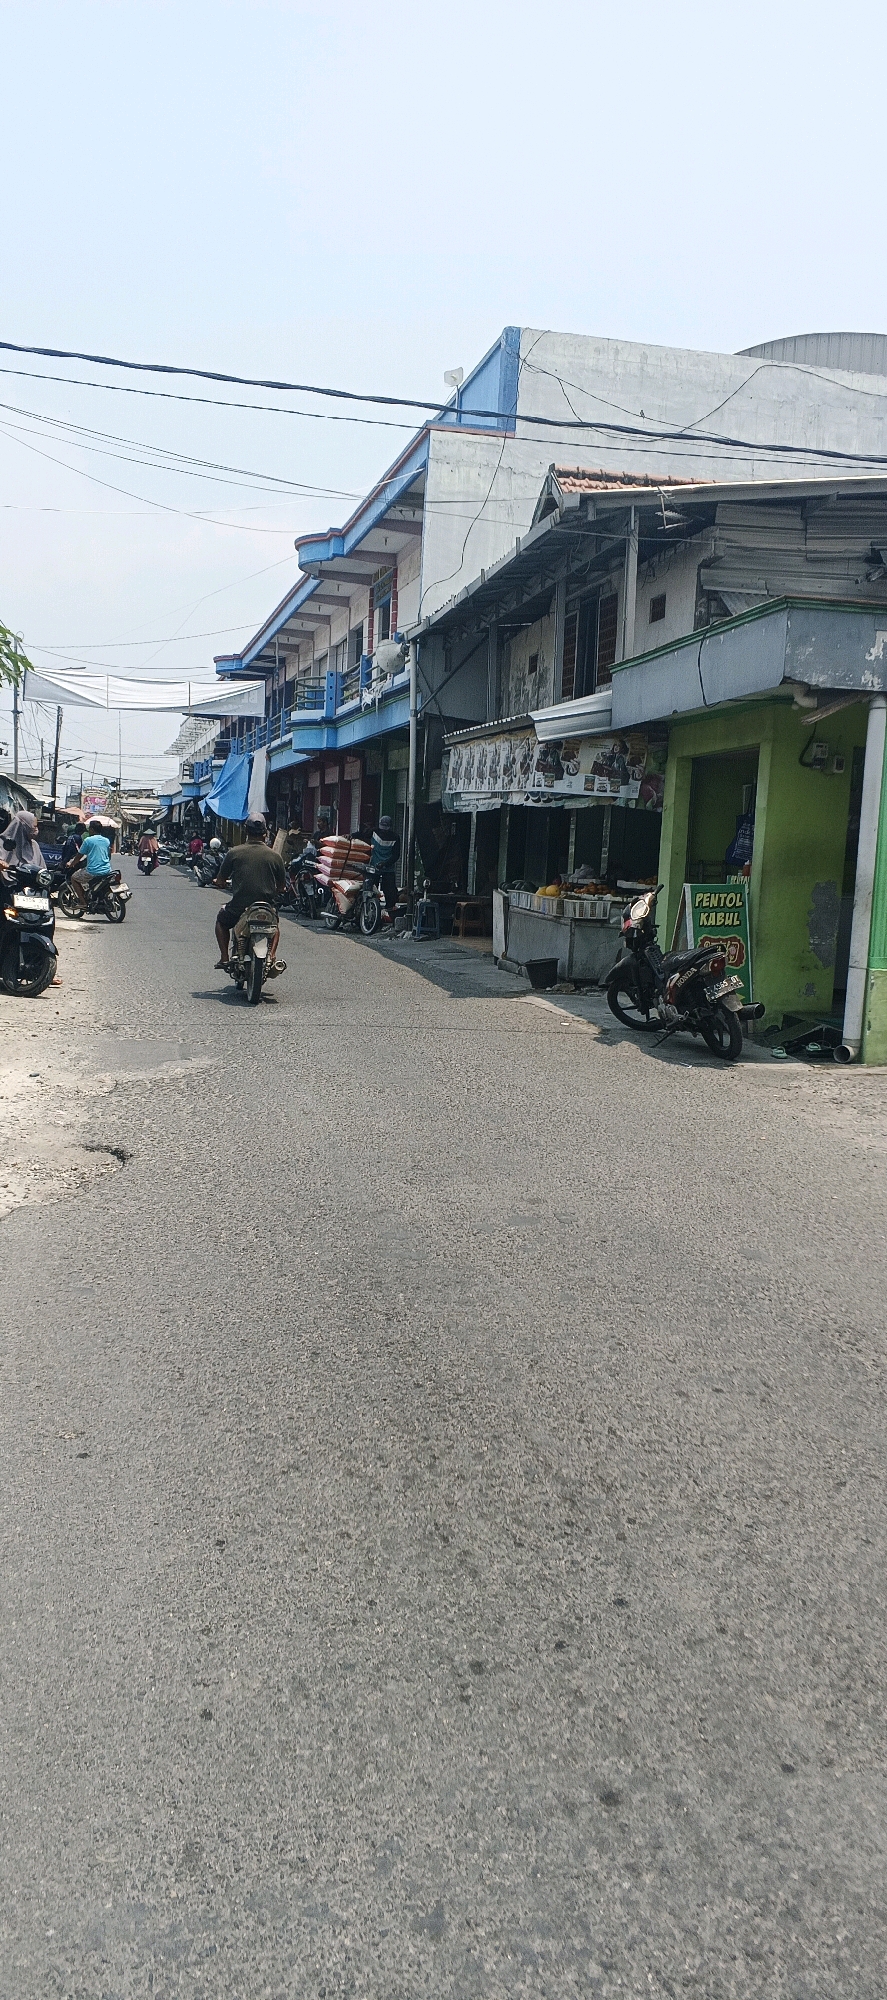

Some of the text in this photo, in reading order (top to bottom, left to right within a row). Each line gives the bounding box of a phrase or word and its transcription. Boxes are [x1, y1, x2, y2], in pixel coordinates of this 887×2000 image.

[695, 892, 743, 908] PENTOL
[699, 911, 740, 926] KABUL
[676, 967, 697, 988] HONDA
